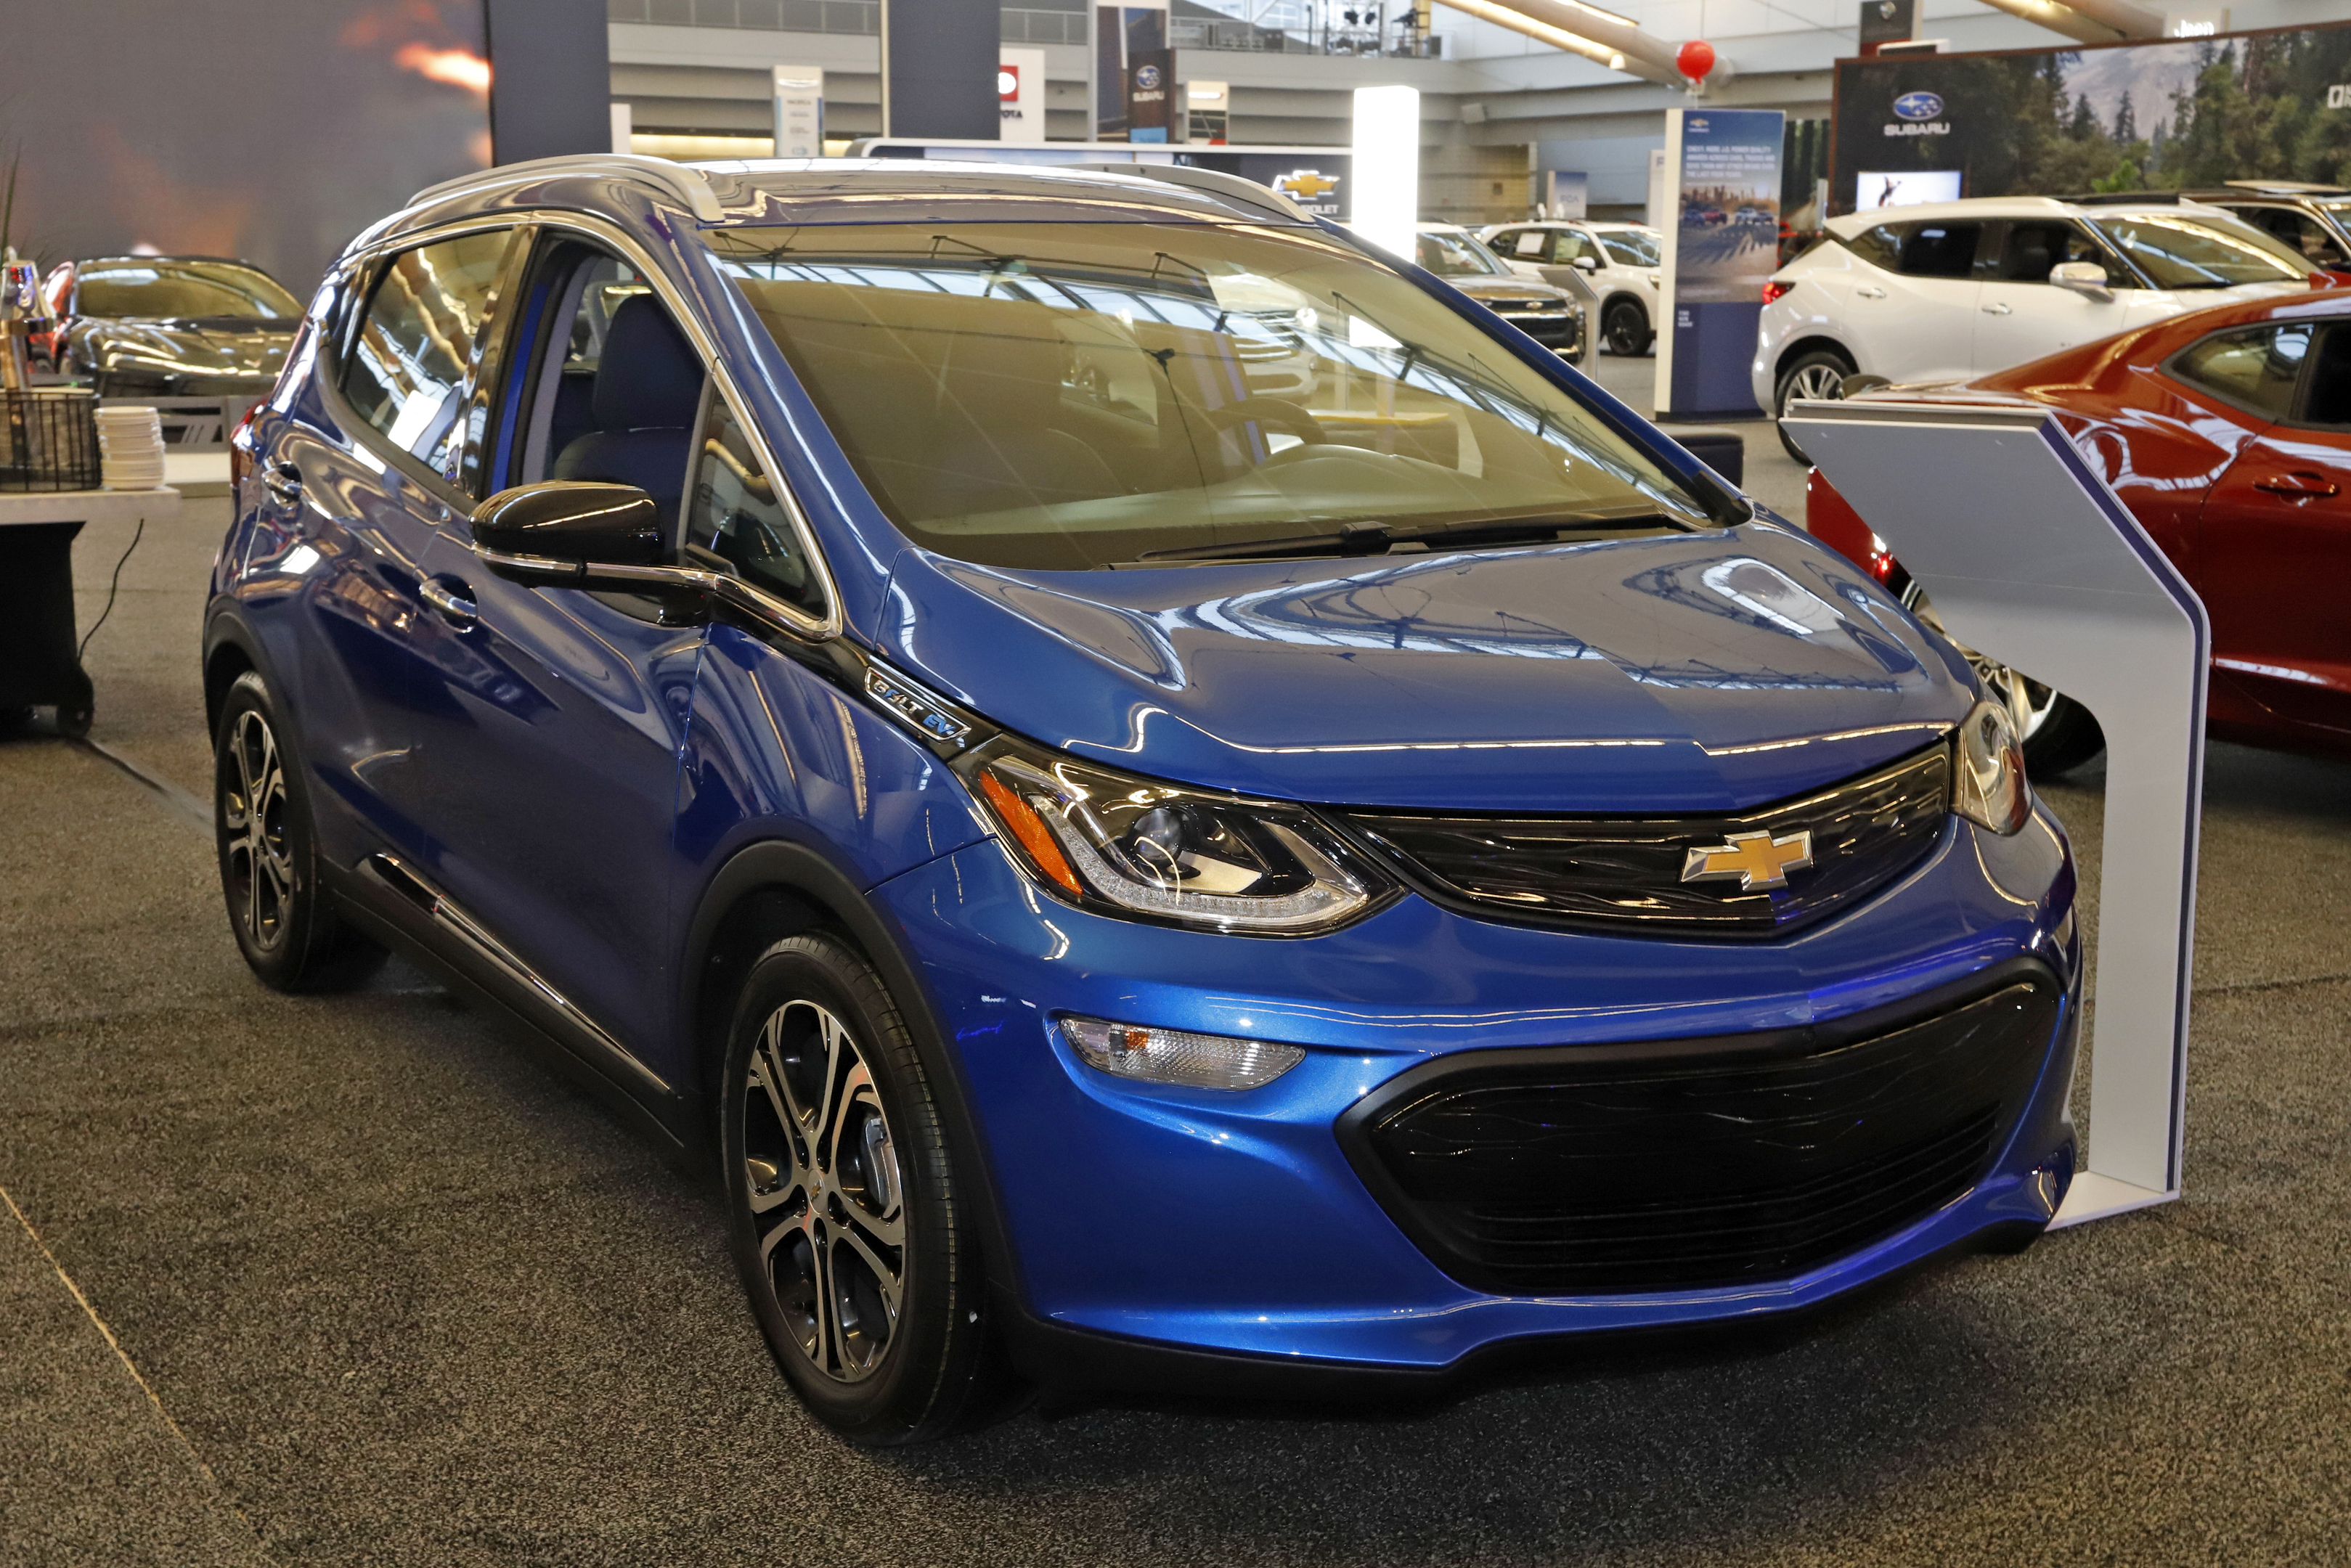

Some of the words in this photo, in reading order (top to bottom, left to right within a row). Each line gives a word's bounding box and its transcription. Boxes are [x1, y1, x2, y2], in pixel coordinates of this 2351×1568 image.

[1001, 110, 1023, 119] OTA
[1883, 122, 1951, 136] SUBARU
[1300, 204, 1339, 214] ROLET
[873, 679, 924, 714] BOLT
[923, 714, 956, 733] EV
